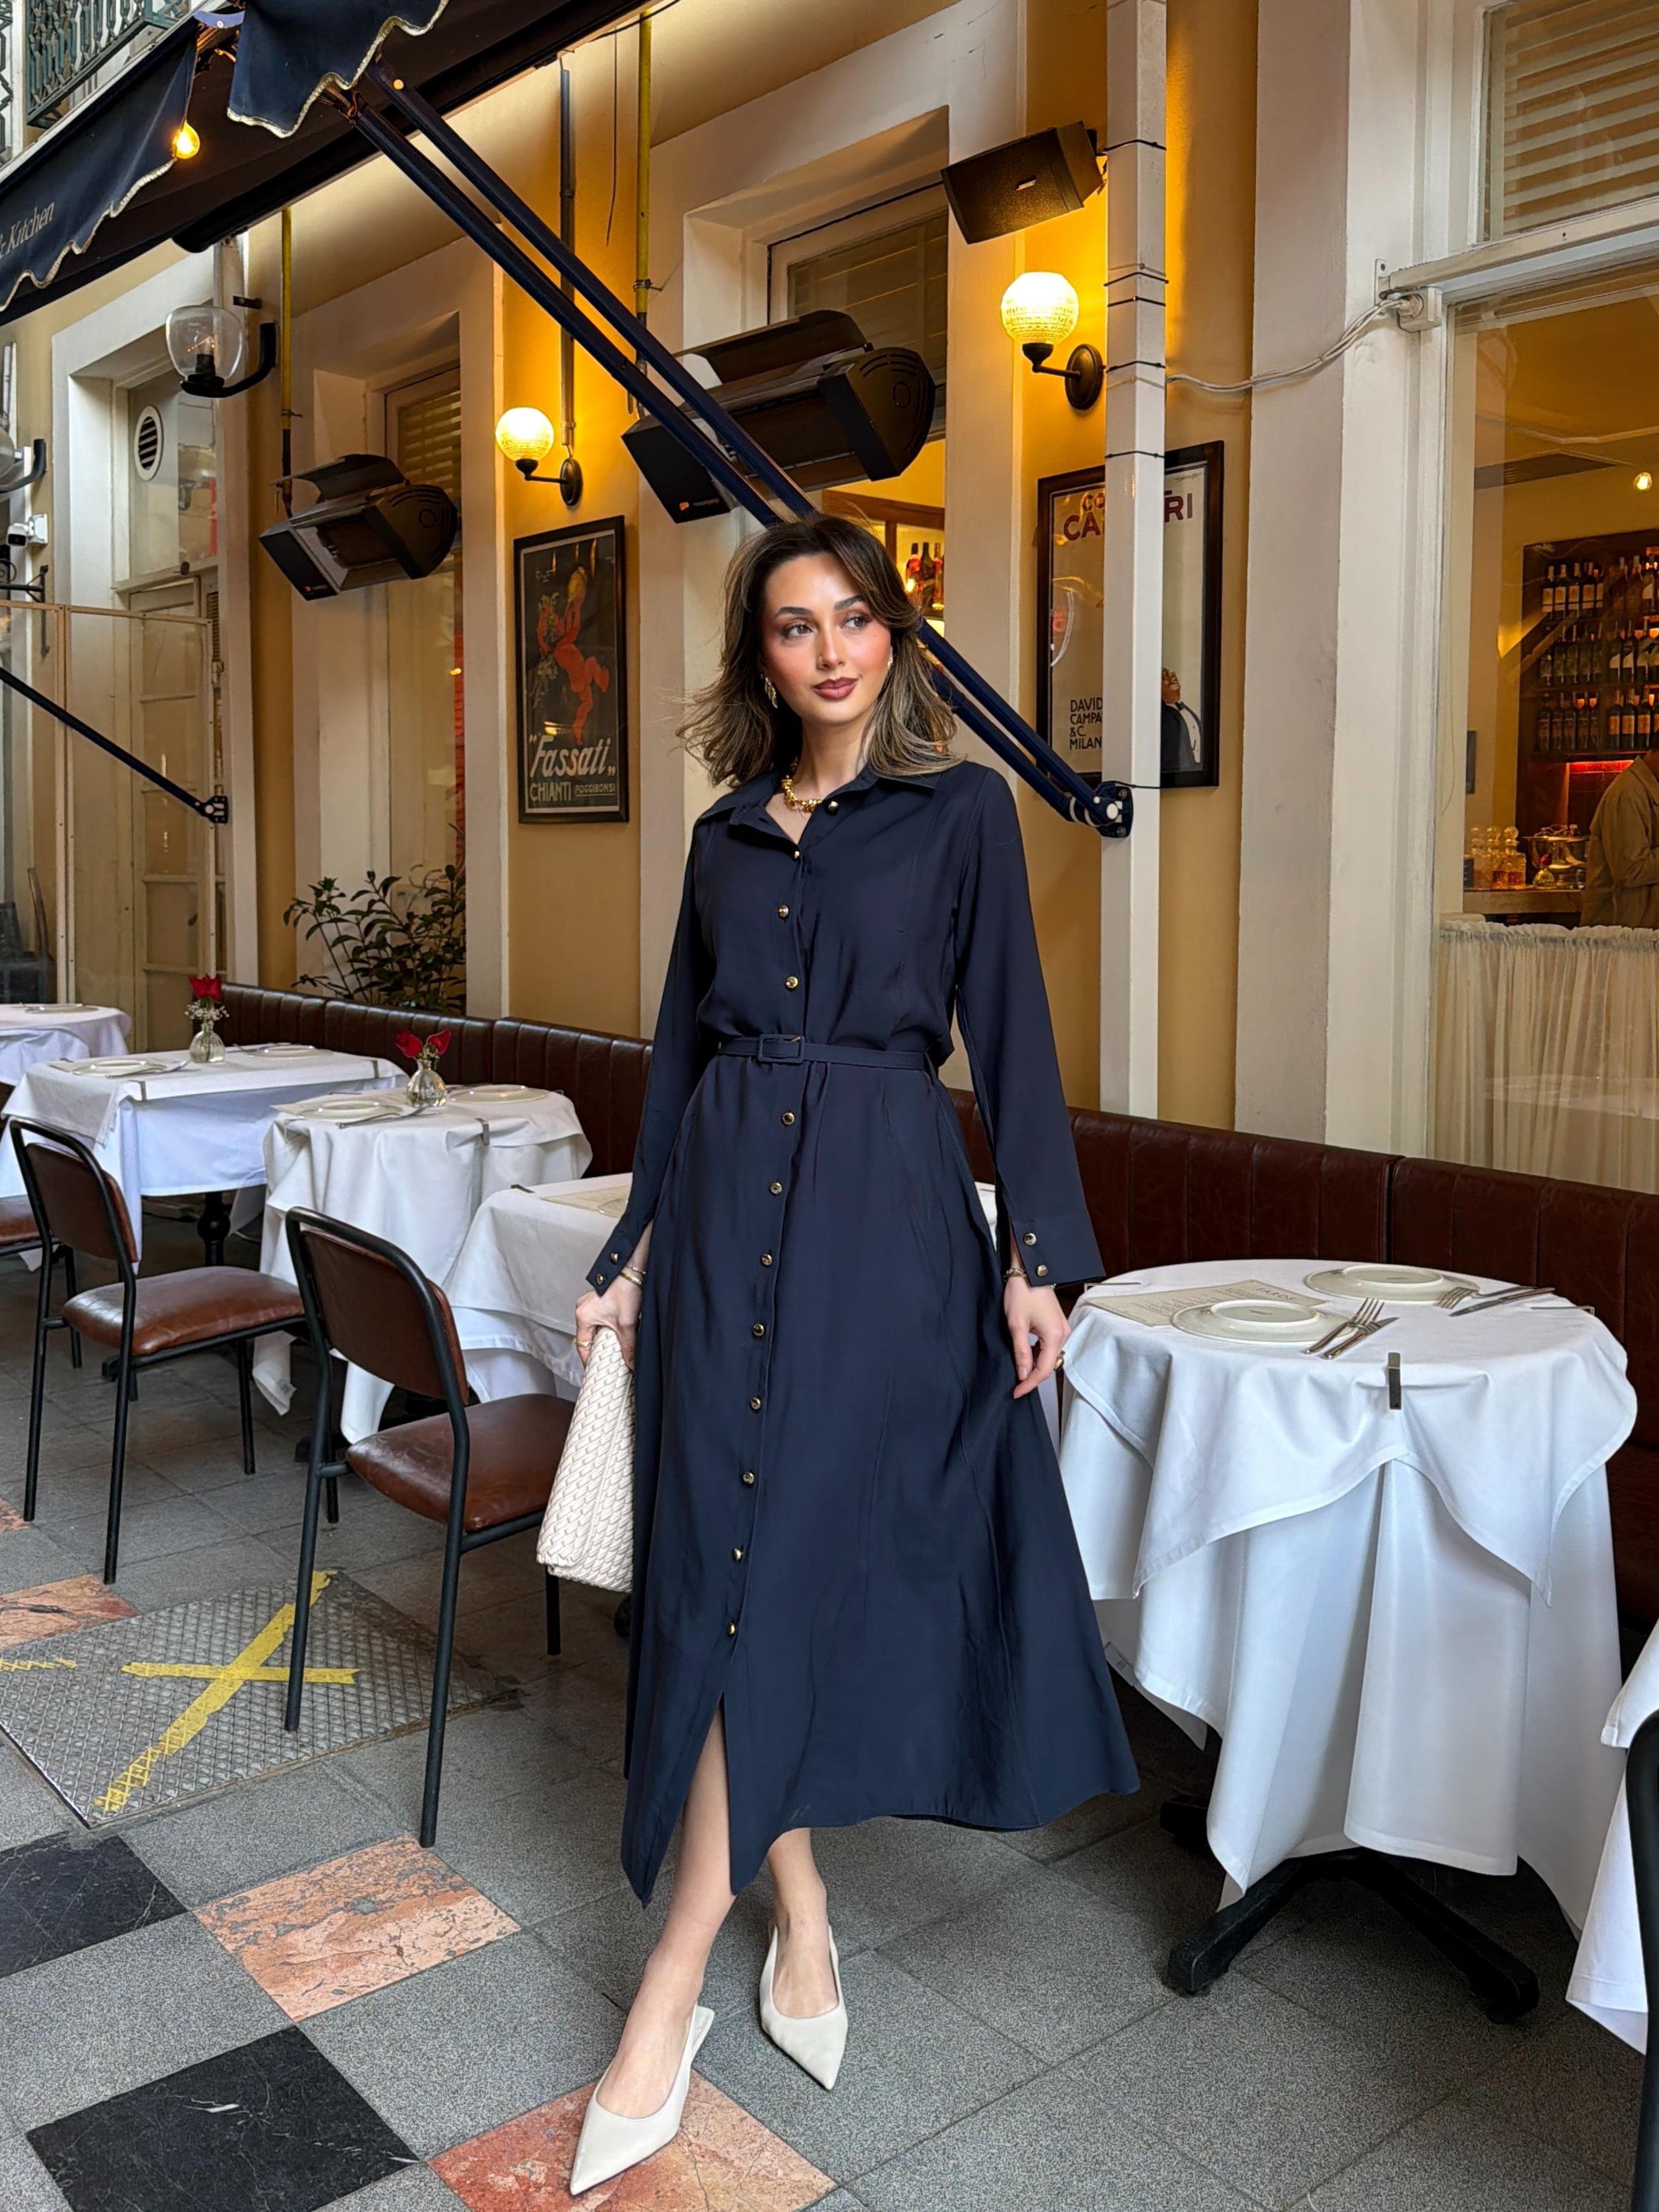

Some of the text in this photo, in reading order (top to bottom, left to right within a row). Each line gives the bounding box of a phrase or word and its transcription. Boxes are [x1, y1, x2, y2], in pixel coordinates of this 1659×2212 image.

[5, 202, 55, 255] Kitchen
[1070, 697, 1103, 712] DAVID
[1070, 712, 1102, 725] CAMPA
[1069, 736, 1102, 750] MILAN
[530, 781, 571, 802] CHIANTI
